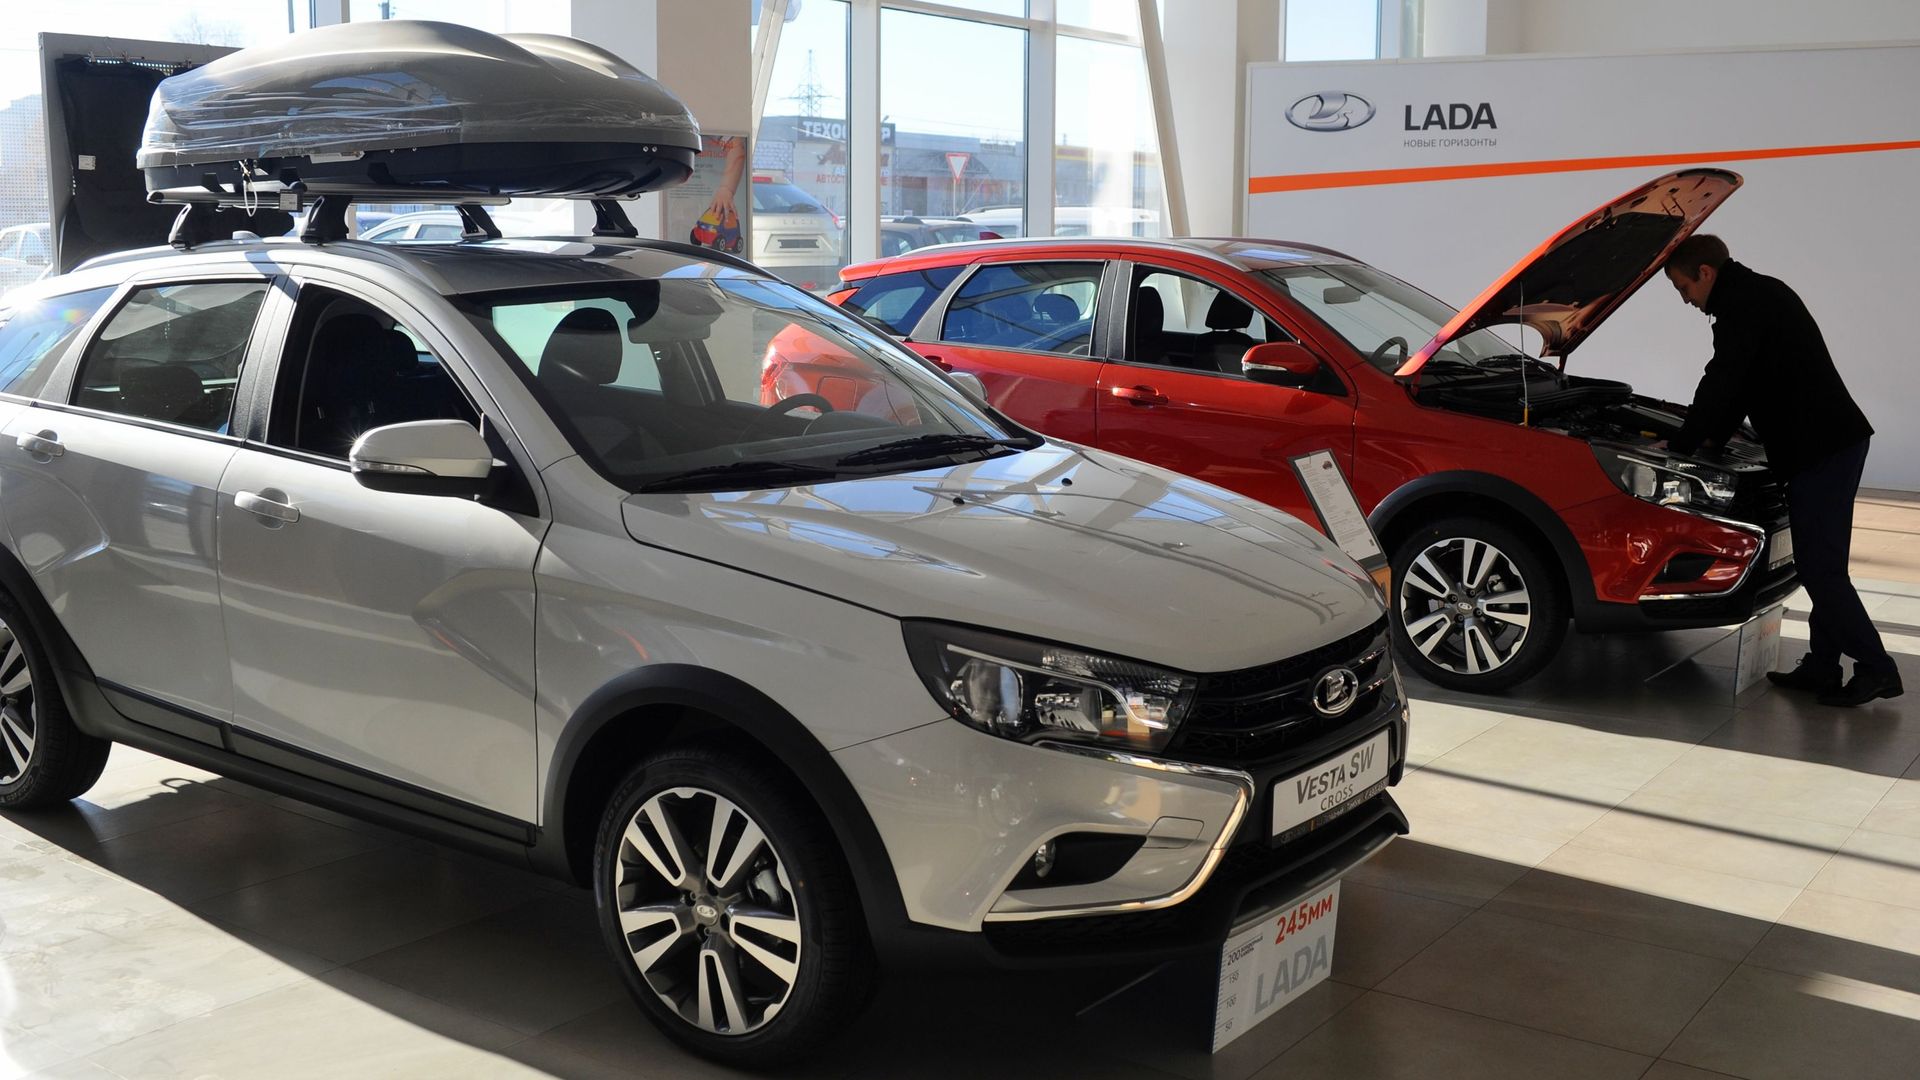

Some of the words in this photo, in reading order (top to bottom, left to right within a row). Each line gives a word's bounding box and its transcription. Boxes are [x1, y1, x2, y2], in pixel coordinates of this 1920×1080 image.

[1404, 102, 1498, 131] LADA
[1403, 138, 1437, 148] НОВЫЕ
[1438, 137, 1498, 148] ГОРИЗОНТЫ
[1296, 764, 1346, 804] VESTA
[1349, 743, 1375, 779] SW
[1320, 784, 1354, 811] CROSS
[1227, 949, 1241, 966] 200
[1228, 971, 1240, 985] 150
[1254, 934, 1328, 1014] LADA
[1224, 1021, 1233, 1032] 50
